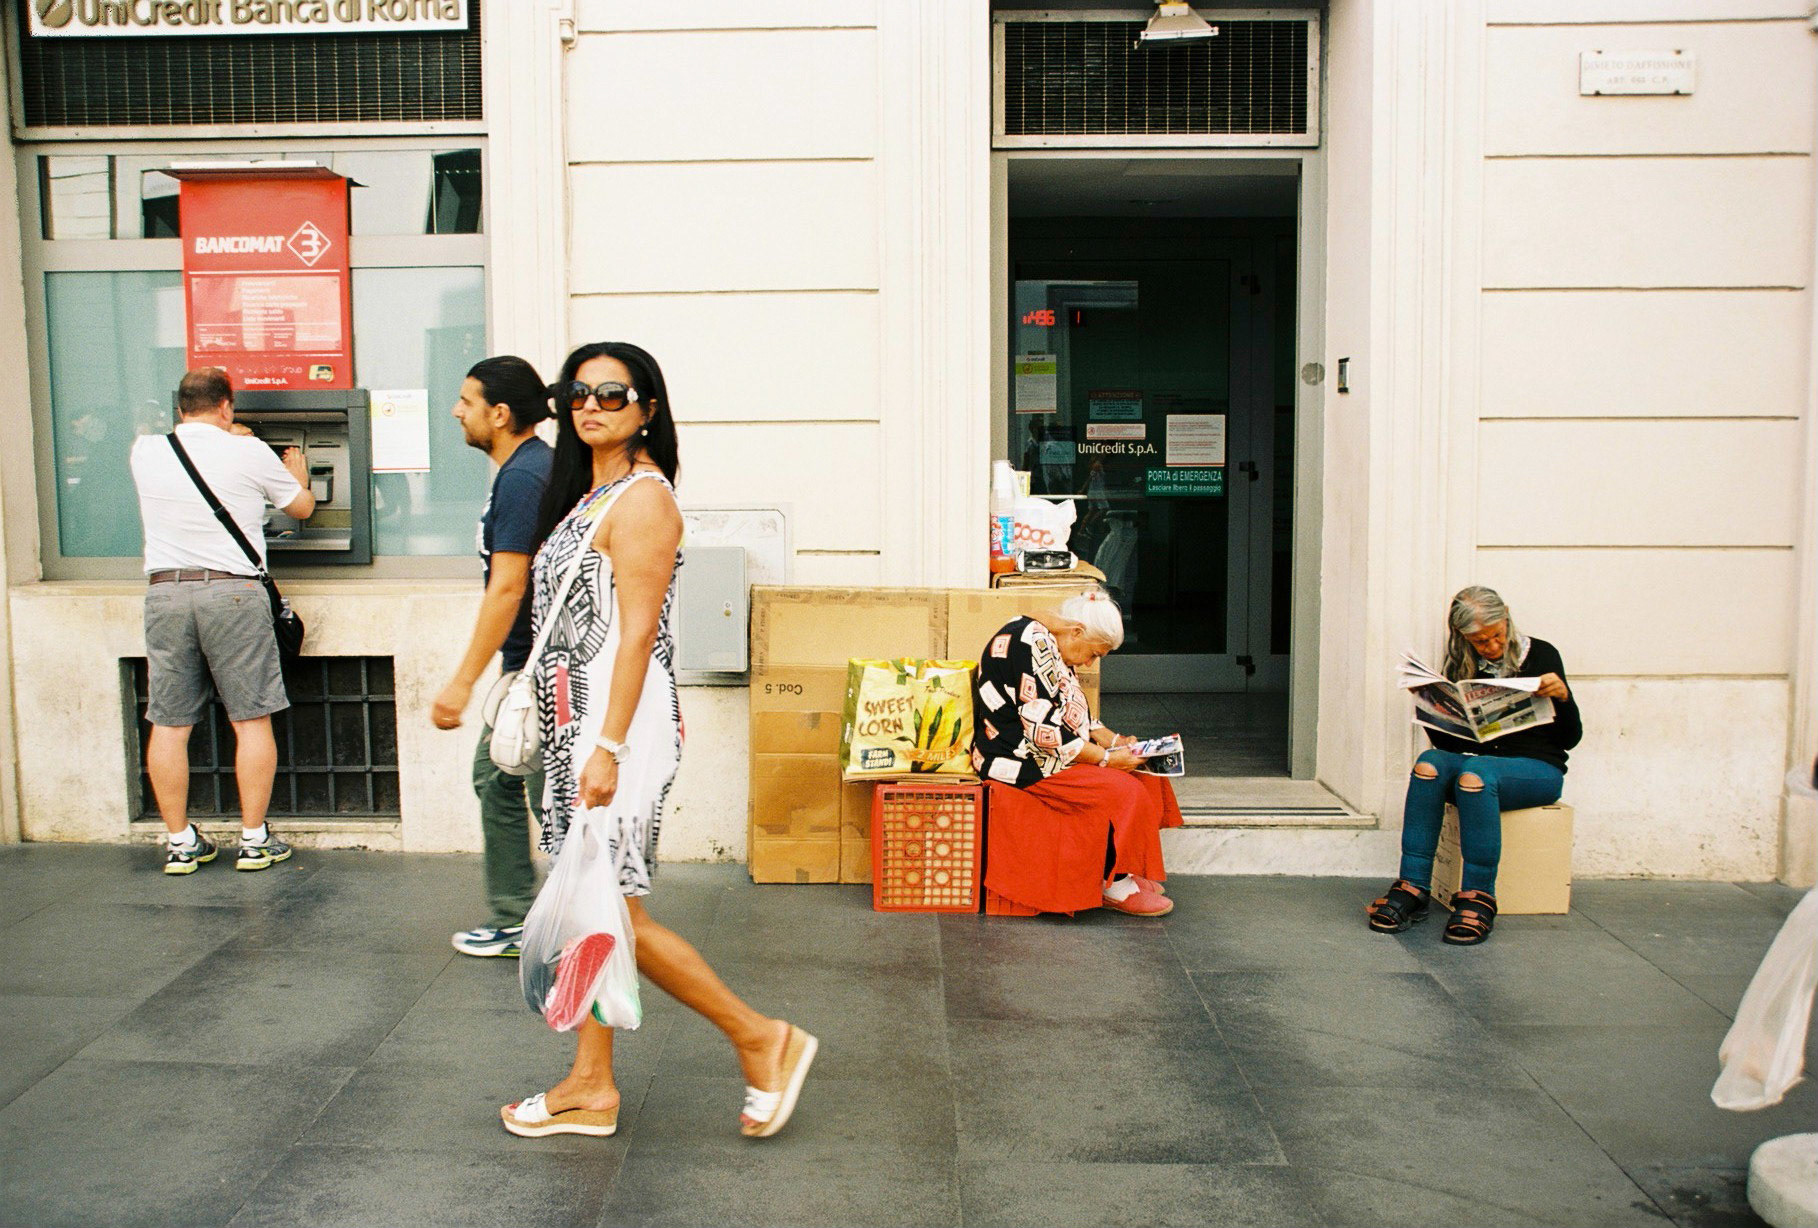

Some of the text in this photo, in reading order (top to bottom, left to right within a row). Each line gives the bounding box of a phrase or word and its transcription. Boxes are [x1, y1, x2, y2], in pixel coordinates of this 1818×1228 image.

[76, 0, 460, 26] UniCredit Banca di Roma
[195, 236, 285, 254] BANCOMAT
[1078, 442, 1157, 456] UniCredit S.p.A.
[1148, 470, 1171, 481] PORTA
[1180, 470, 1222, 481] EMERGENZA
[765, 683, 803, 696] Cod. 5
[864, 695, 914, 716] SWEET
[858, 717, 904, 736] CORN
[868, 750, 889, 760] FARM
